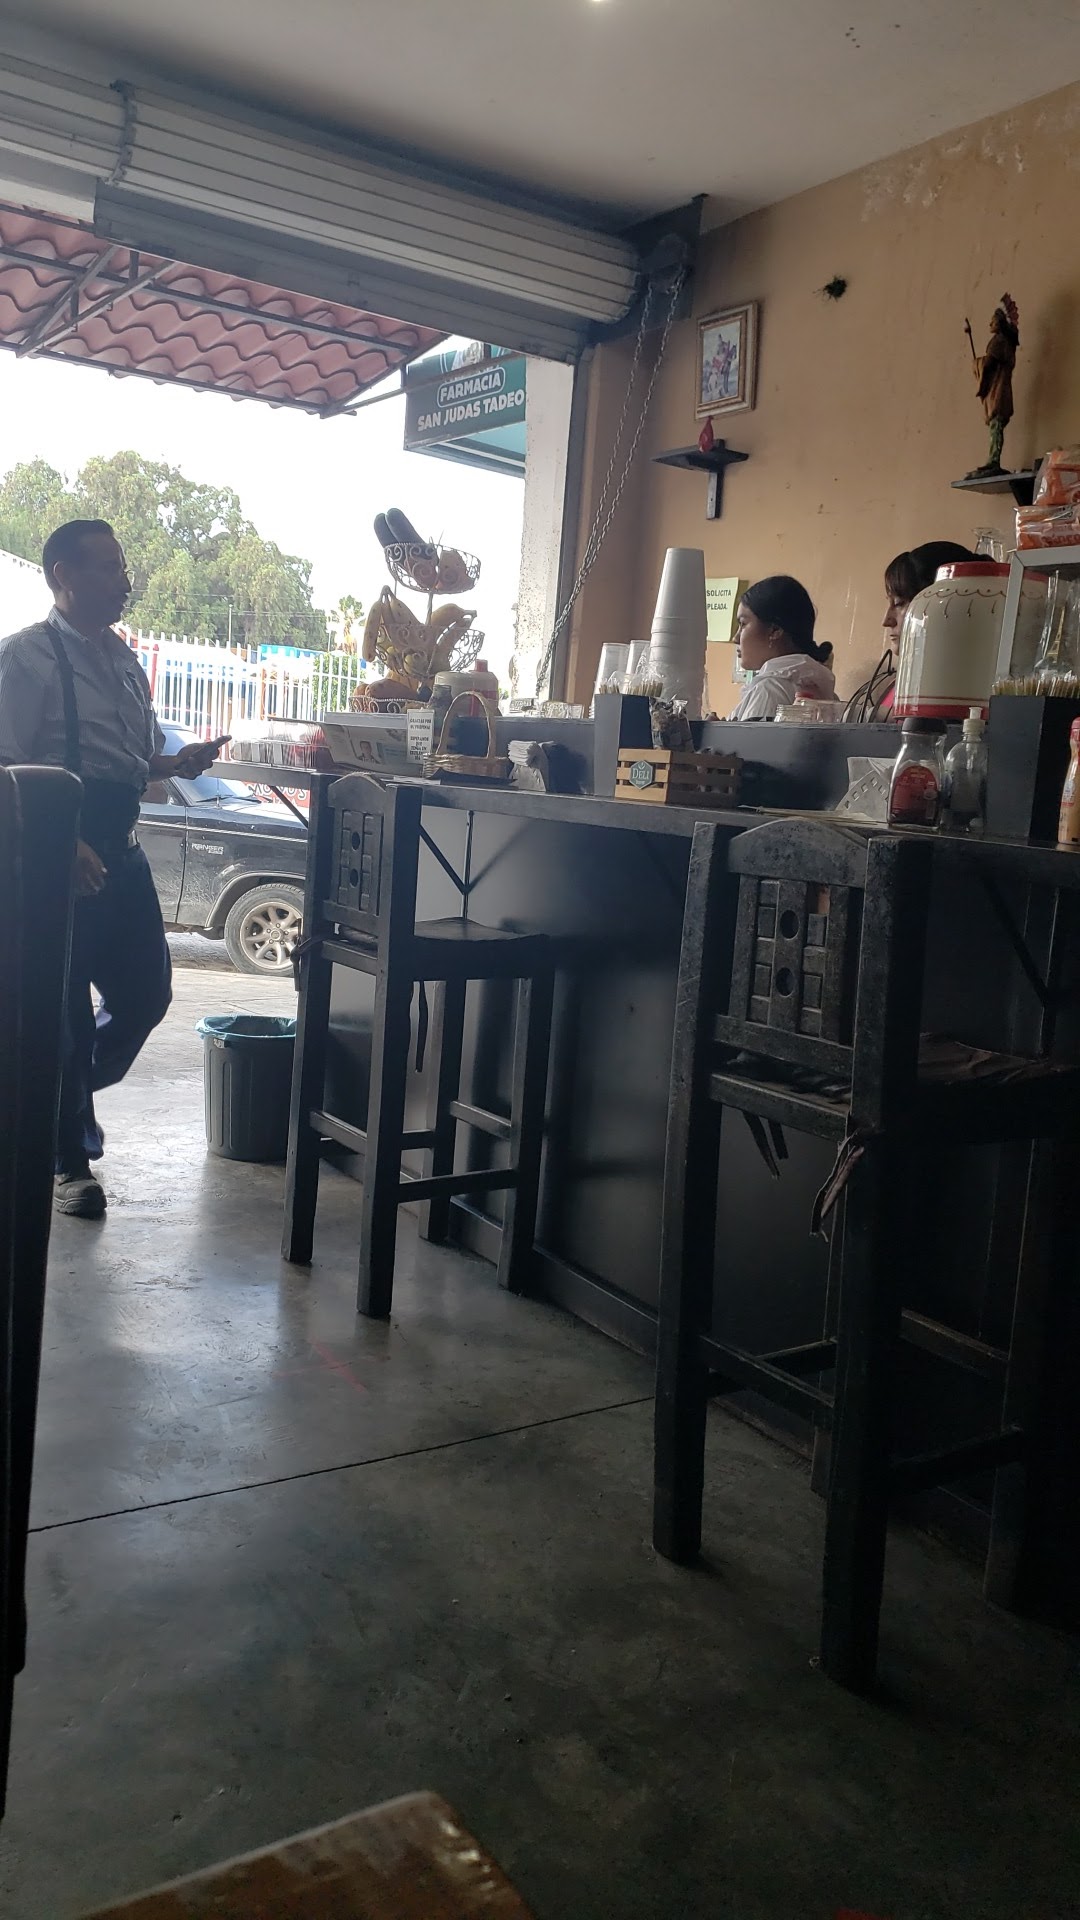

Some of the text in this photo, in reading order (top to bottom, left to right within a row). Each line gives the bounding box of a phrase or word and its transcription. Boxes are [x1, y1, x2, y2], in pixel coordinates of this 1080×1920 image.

[440, 372, 501, 402] FARMACIA
[417, 389, 525, 432] SAN JUDAS TADEO
[706, 589, 732, 597] SOLICITA
[632, 767, 650, 780] DELI
